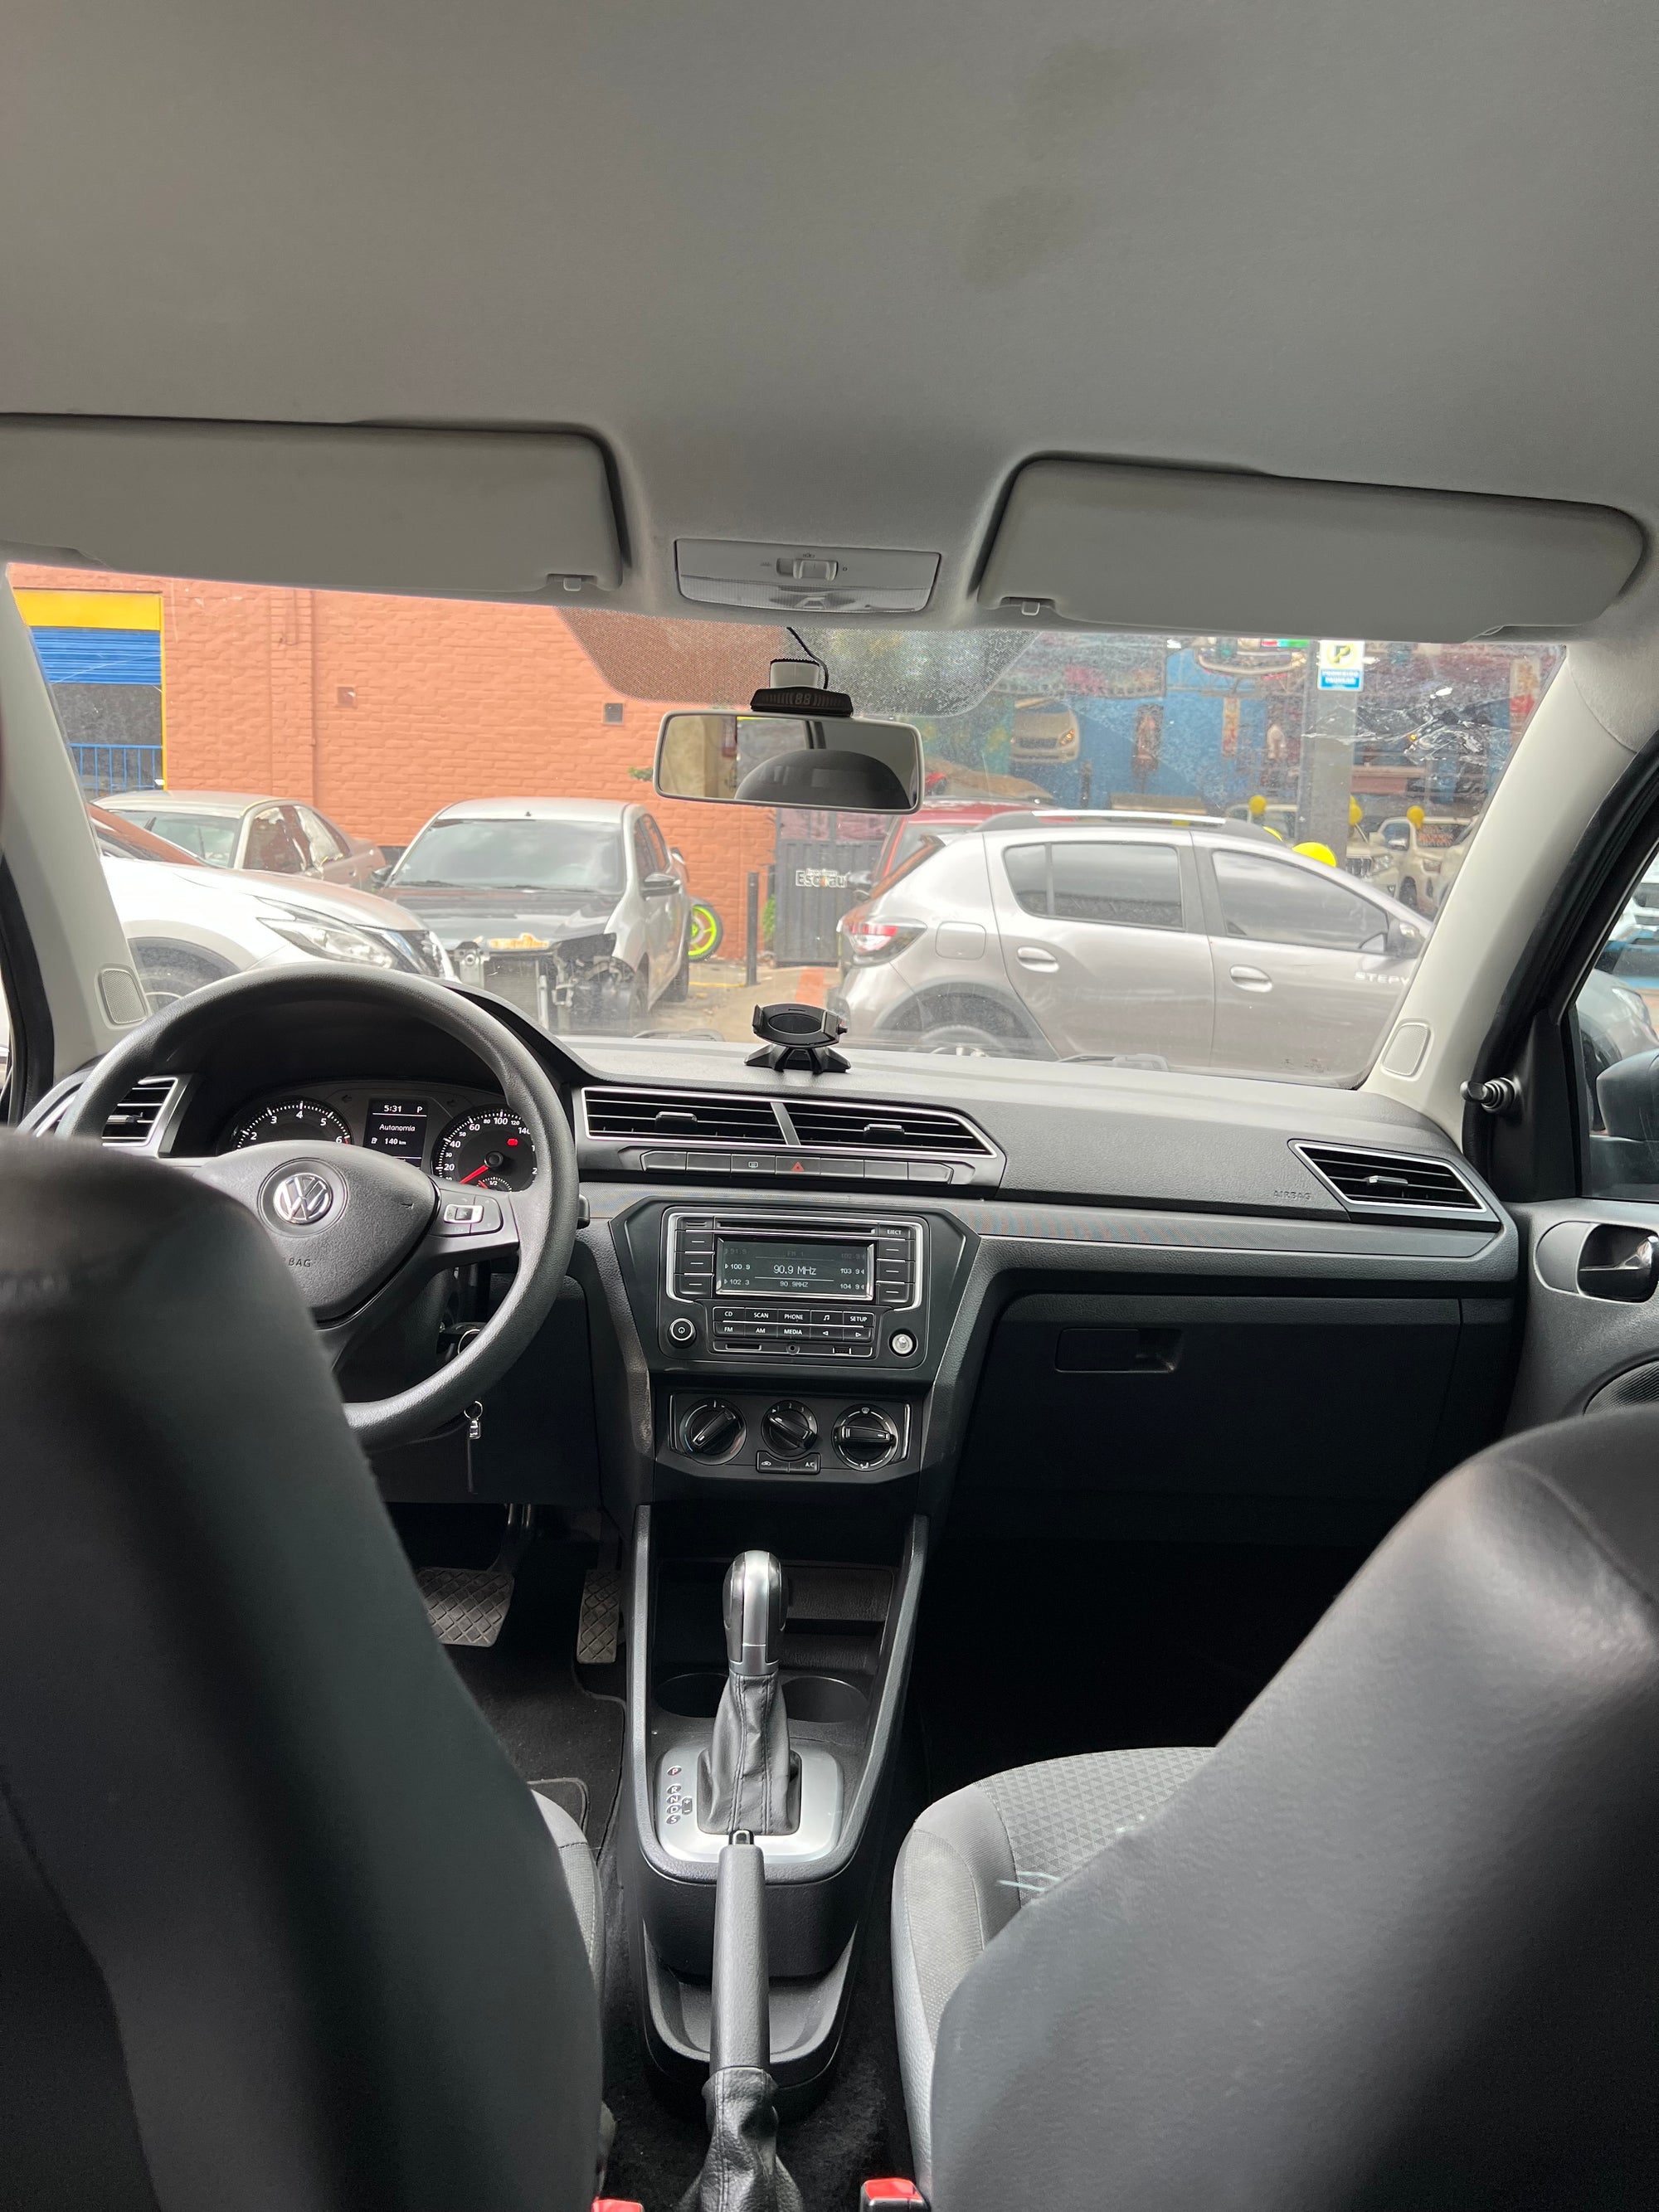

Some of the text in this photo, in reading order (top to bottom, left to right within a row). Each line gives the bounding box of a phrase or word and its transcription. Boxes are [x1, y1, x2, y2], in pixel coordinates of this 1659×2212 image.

[295, 1111, 304, 1119] 4
[270, 1116, 278, 1124] 3
[319, 1118, 328, 1126] 5
[494, 1117, 508, 1125] 100
[250, 1132, 258, 1140] 2
[335, 1135, 343, 1144] 6
[773, 1265, 817, 1276] 90.9 MHz
